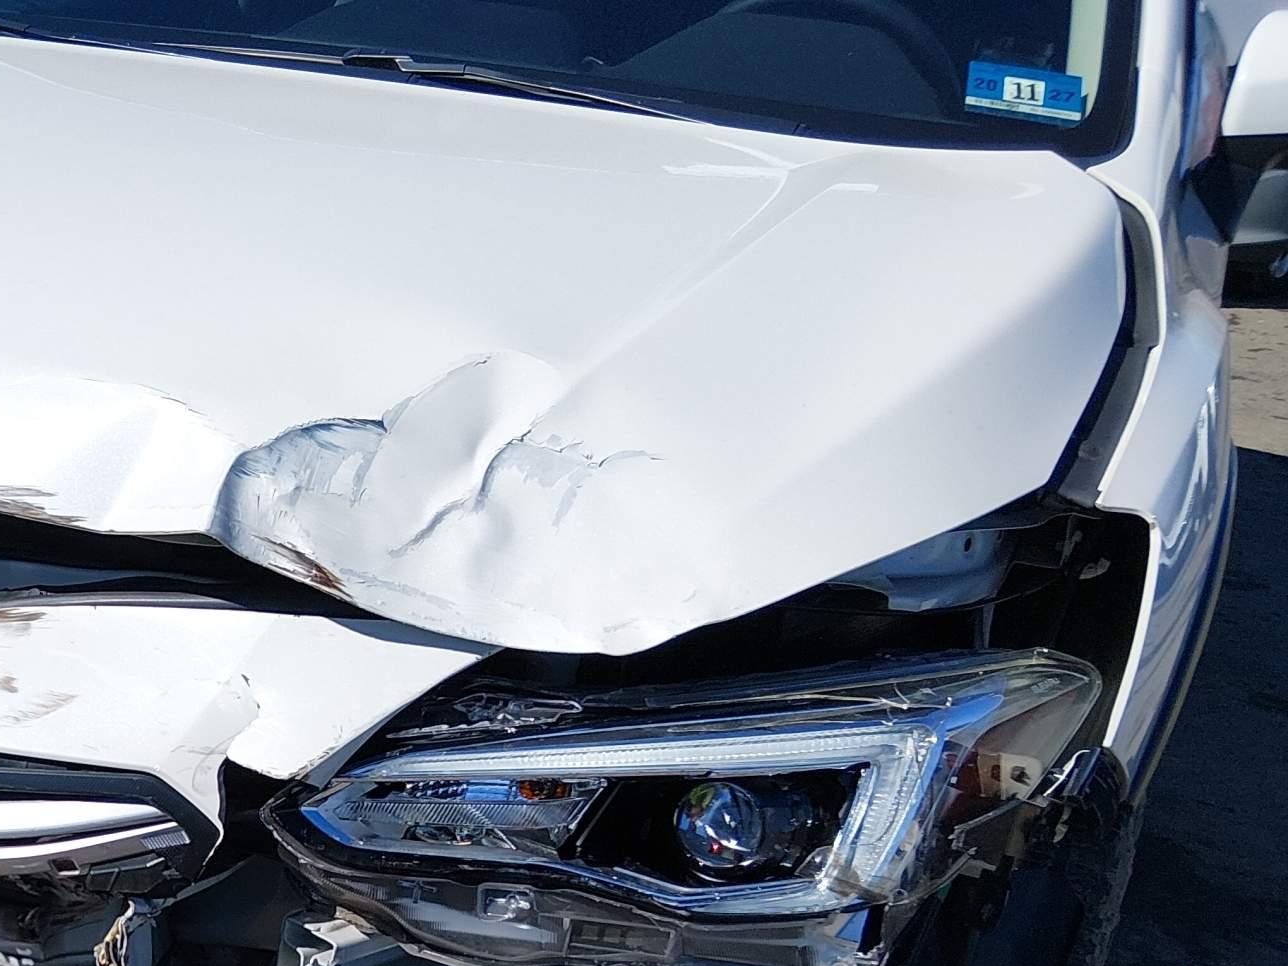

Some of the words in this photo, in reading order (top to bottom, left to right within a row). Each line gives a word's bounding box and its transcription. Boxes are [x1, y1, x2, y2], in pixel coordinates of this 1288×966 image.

[974, 77, 998, 92] 20
[1013, 83, 1040, 102] 11
[1048, 90, 1075, 104] 27
